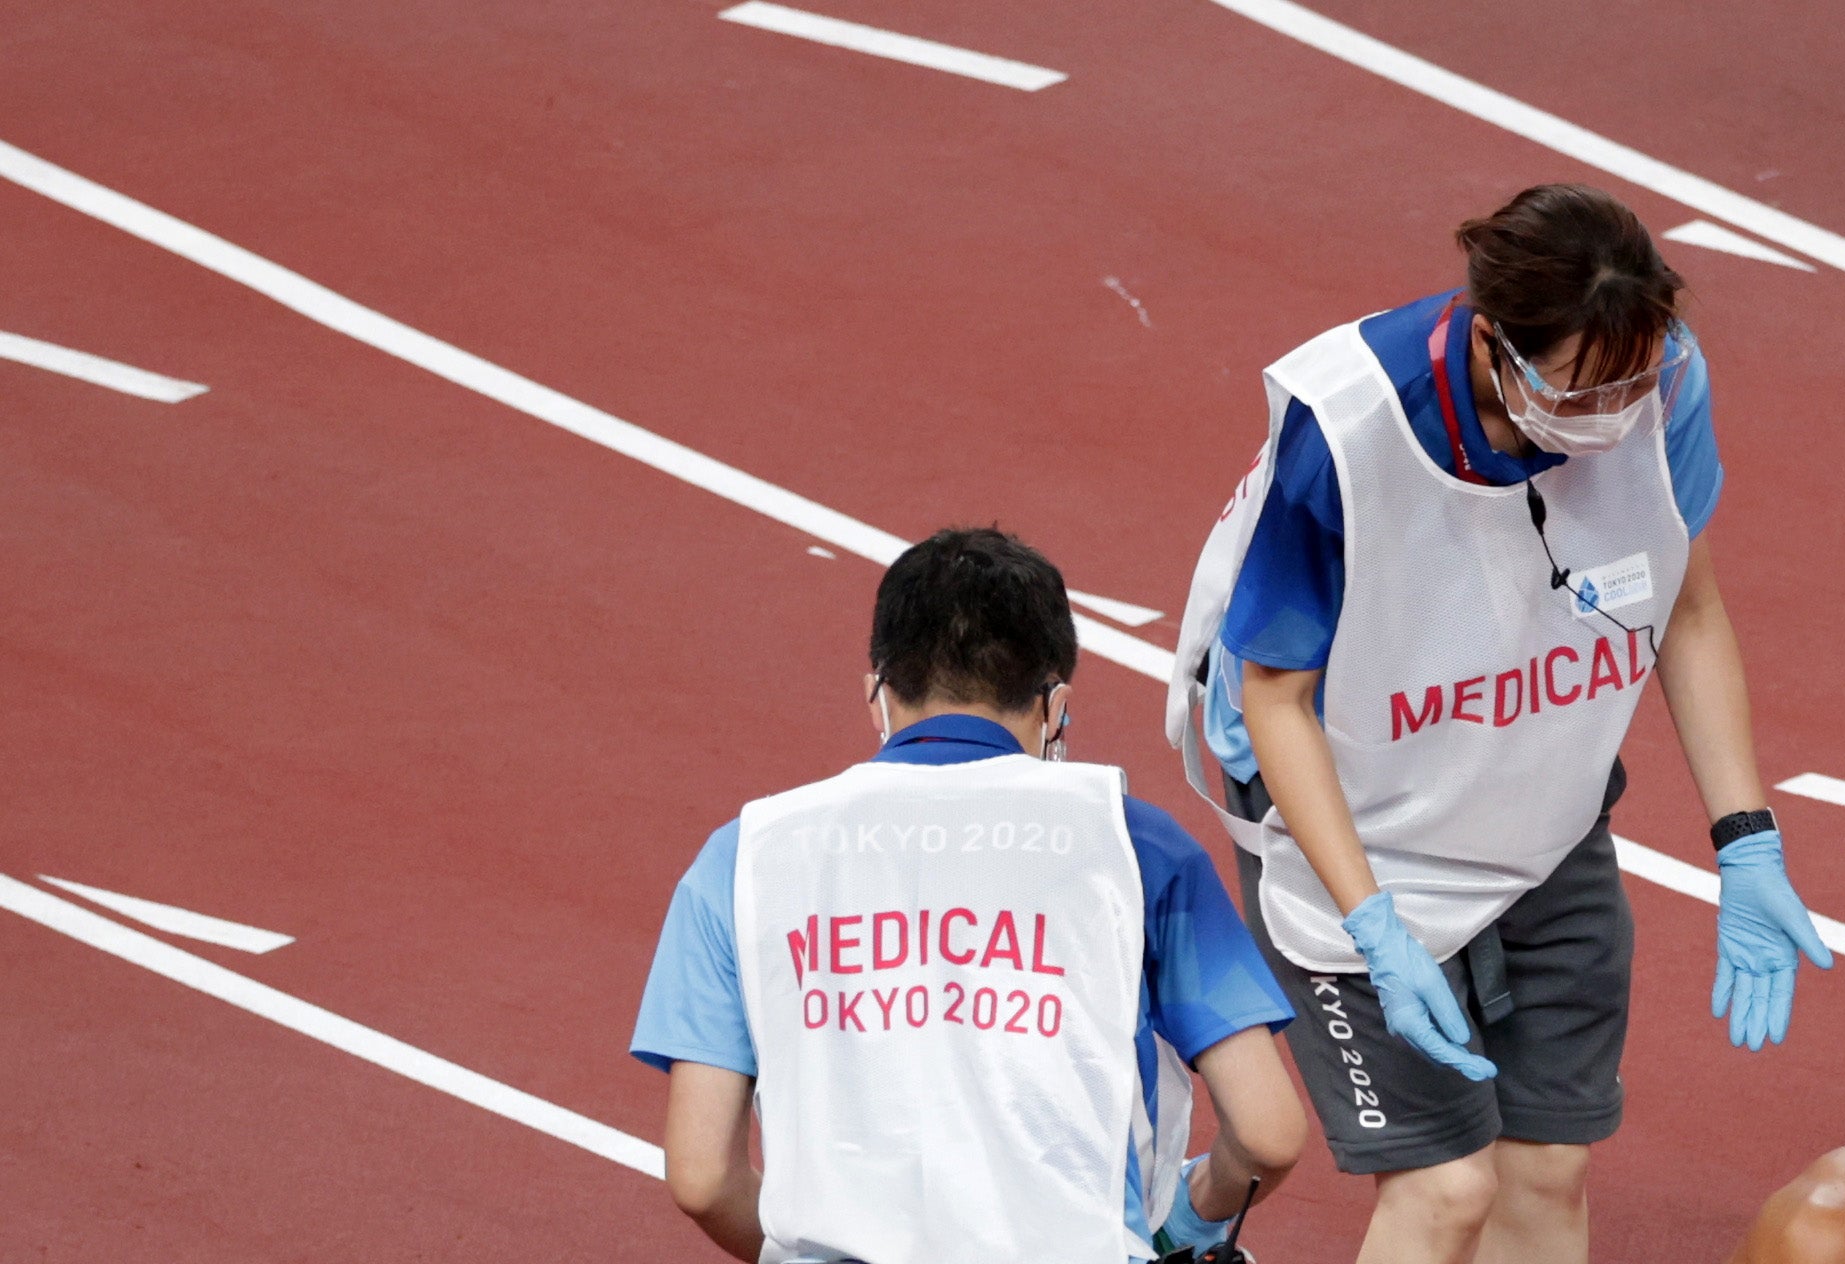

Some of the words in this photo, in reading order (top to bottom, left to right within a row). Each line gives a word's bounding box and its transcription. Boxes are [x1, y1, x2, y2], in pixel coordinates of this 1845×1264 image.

[1390, 628, 1646, 741] MEDICAL
[792, 821, 947, 853] TOKYO
[961, 821, 1073, 854] 2020
[787, 907, 1065, 991] MEDICAL
[803, 985, 929, 1033] OKYO
[943, 981, 1063, 1038] 2020
[1310, 976, 1353, 1040] KYO
[1340, 1047, 1387, 1128] 2020
